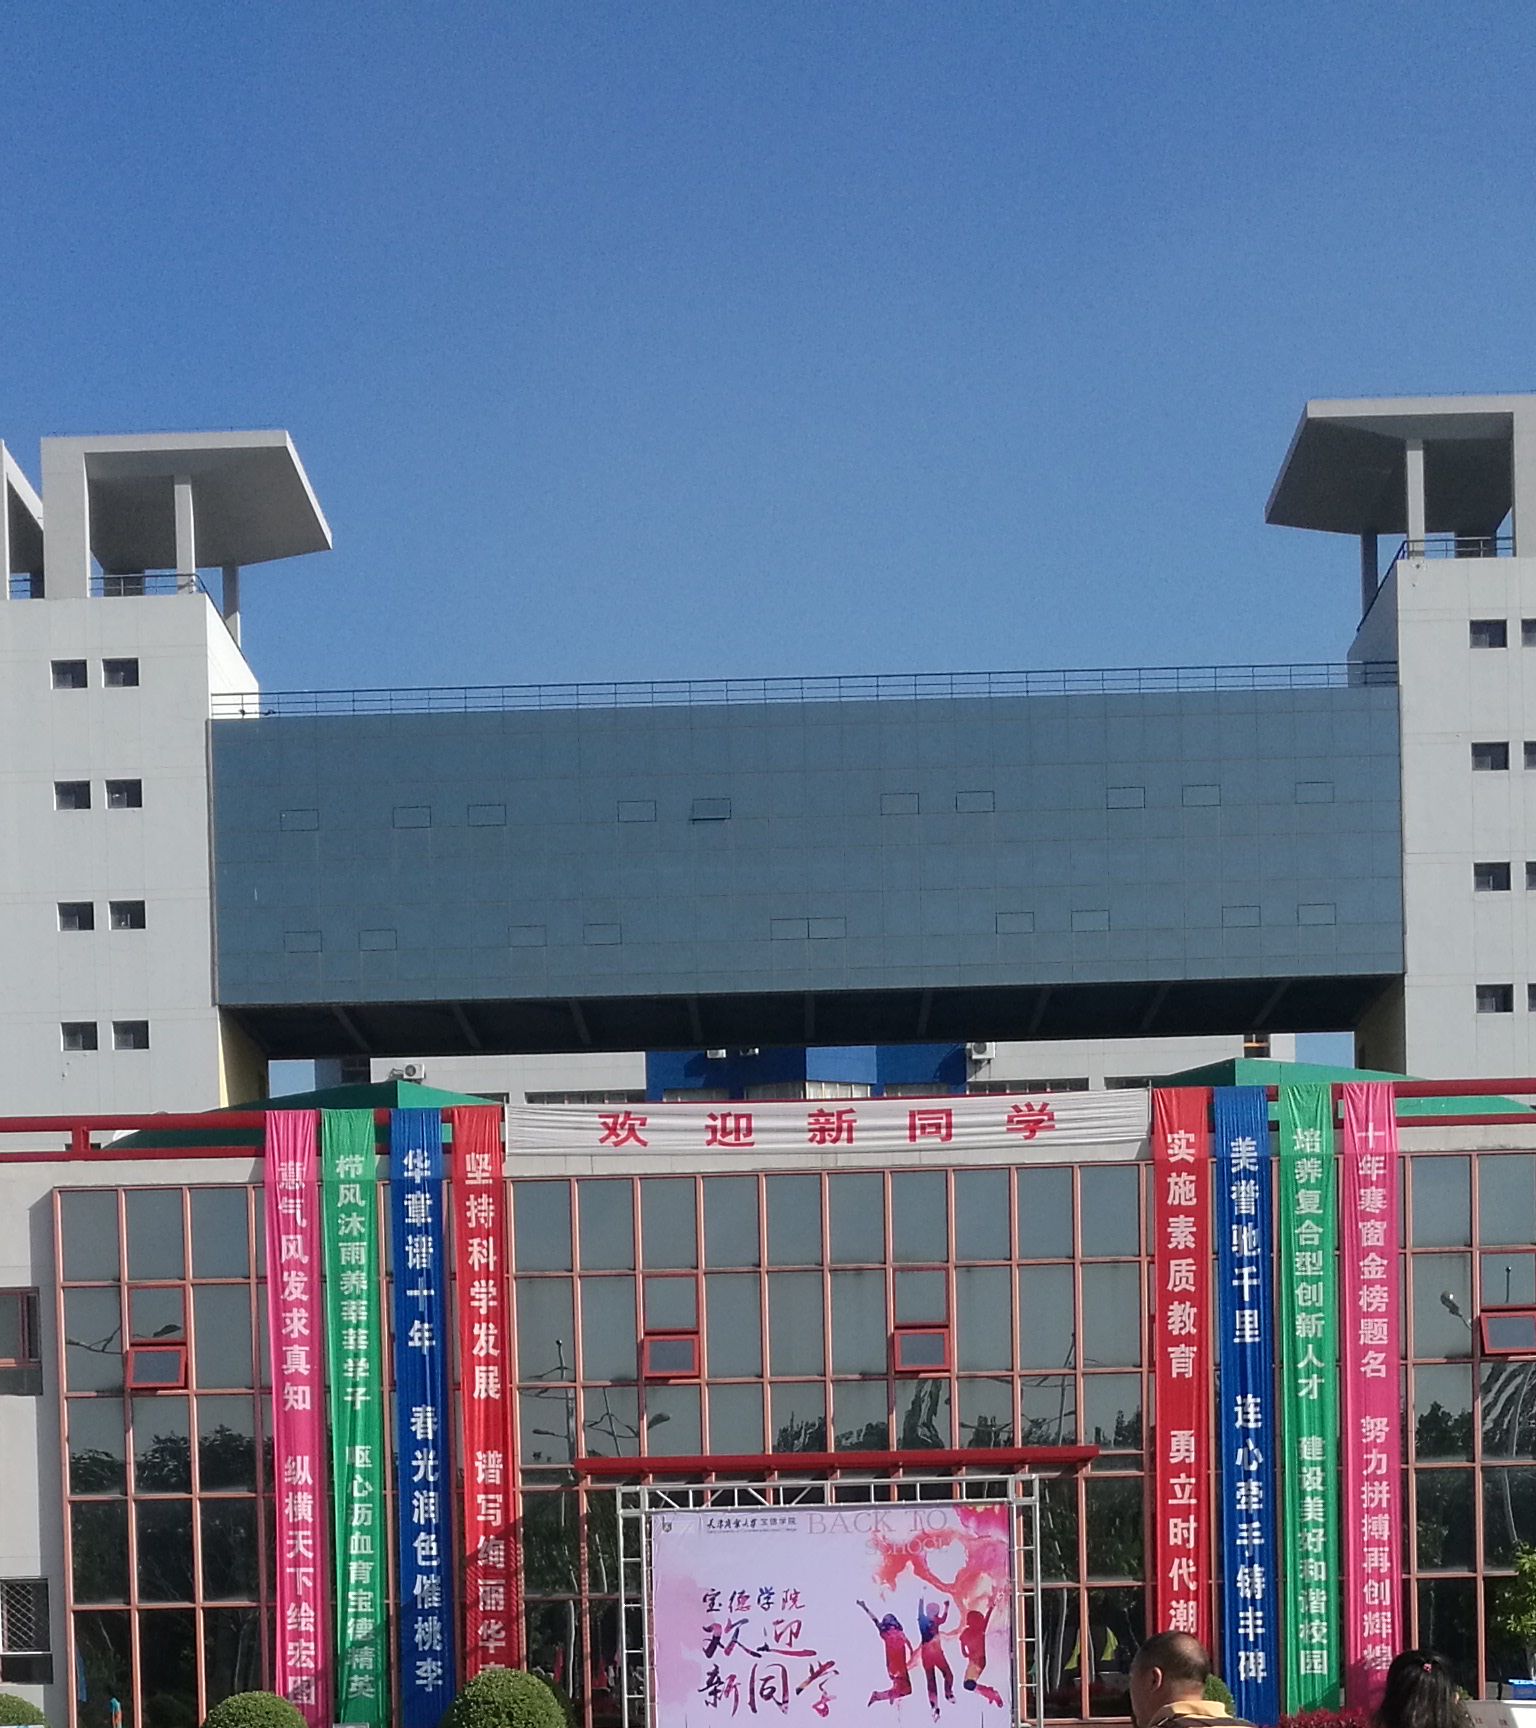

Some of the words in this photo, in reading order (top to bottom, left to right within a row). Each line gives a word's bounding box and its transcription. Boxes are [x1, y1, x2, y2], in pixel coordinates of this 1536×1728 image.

[597, 1101, 1056, 1148] 欢迎新同学
[806, 1509, 896, 1535] BACK
[474, 1451, 506, 1672] 谱写绚丽华
[703, 1586, 806, 1613] 宝德学院
[702, 1618, 818, 1659] 欢迎
[697, 1661, 840, 1718] 新同学
